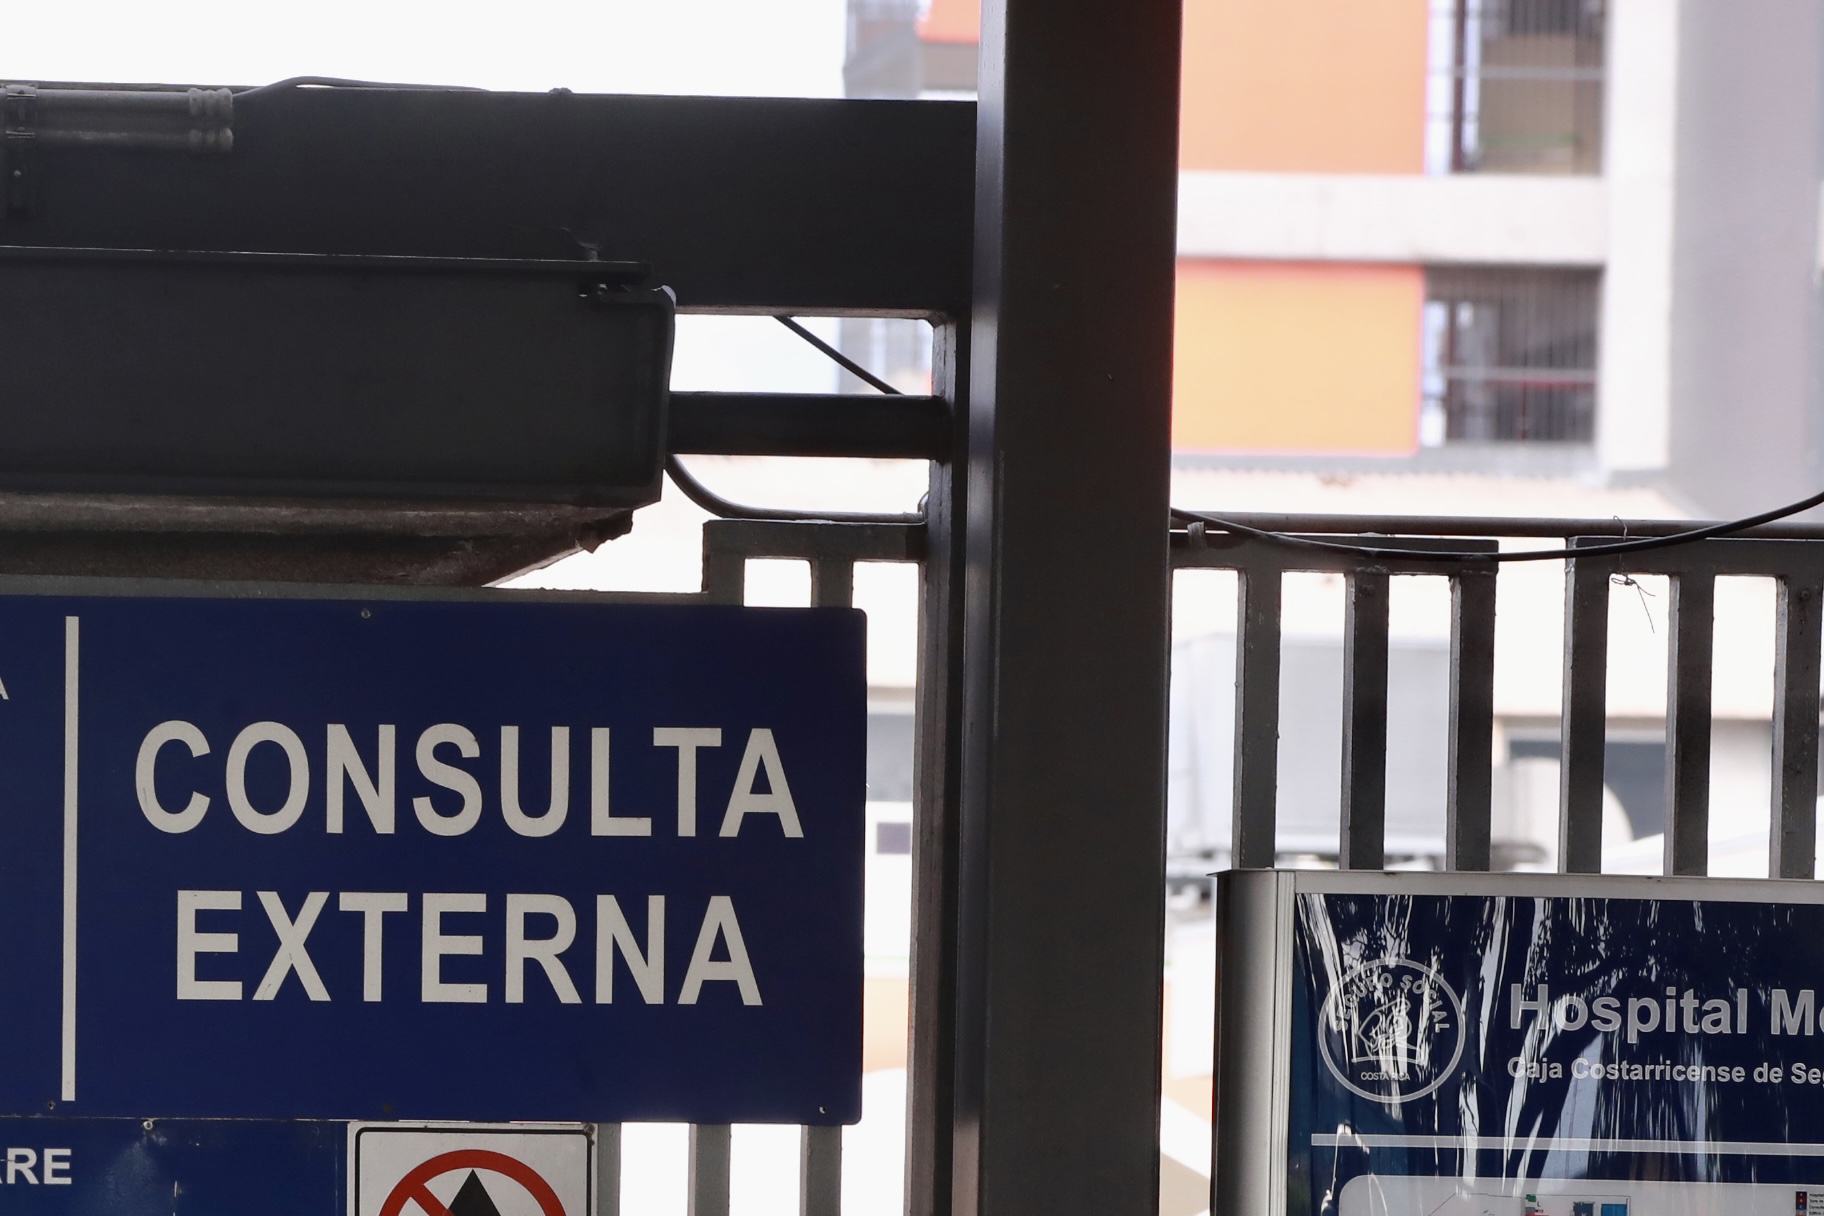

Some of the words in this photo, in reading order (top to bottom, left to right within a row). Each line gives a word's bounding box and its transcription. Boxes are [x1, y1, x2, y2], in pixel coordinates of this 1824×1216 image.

[135, 720, 804, 839] CONSULTA
[176, 889, 763, 1006] EXTERNA
[1335, 973, 1393, 1031] SEGURO
[1400, 974, 1450, 1033] SOCIAL
[1509, 983, 1748, 1044] Hospital
[1361, 1071, 1389, 1081] COSTA
[1507, 1057, 1563, 1083] Caja
[1570, 1057, 1746, 1083] Costarricense
[1753, 1062, 1783, 1083] de
[1790, 1062, 1824, 1088] Se
